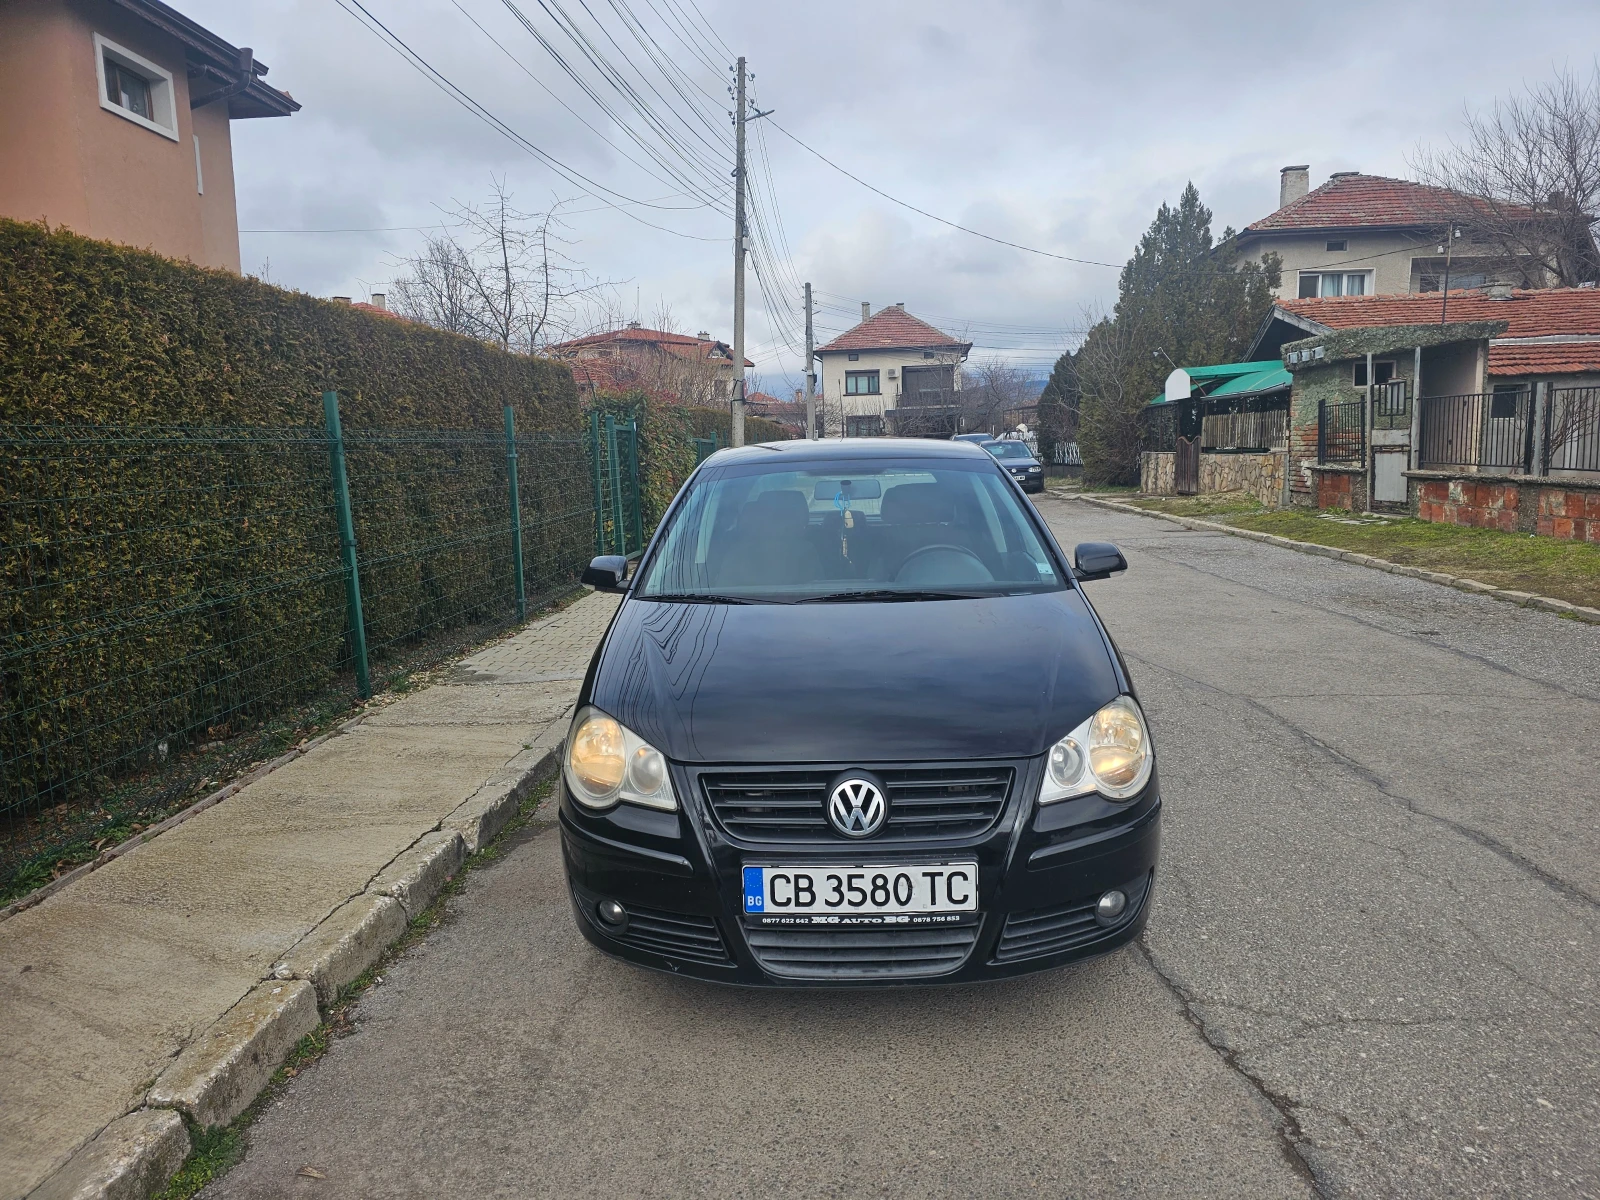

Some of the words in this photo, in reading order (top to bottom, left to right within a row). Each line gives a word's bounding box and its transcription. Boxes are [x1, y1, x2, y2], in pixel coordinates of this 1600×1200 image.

[747, 895, 762, 906] BG
[769, 873, 817, 908] CB
[824, 873, 913, 908] 3580
[922, 871, 969, 906] TC
